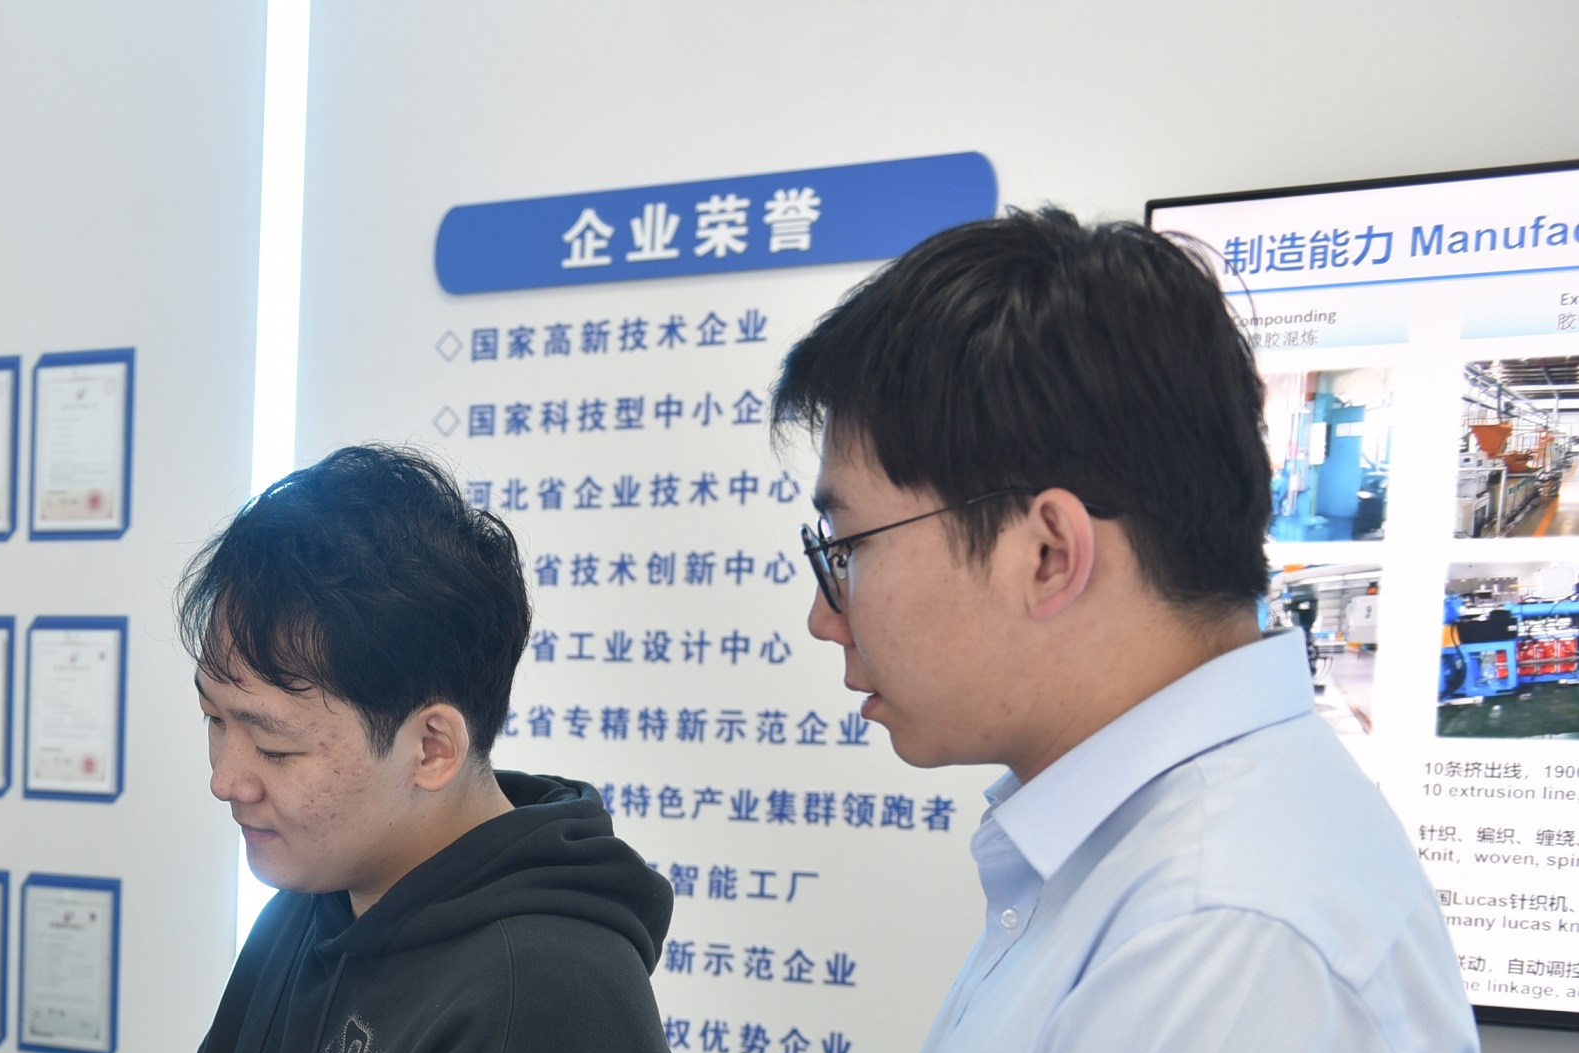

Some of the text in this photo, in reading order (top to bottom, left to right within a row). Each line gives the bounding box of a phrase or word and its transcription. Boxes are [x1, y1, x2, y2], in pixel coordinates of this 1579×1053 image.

[562, 187, 822, 269] 企业荣誉
[1223, 213, 1579, 276] 制造能力 Manufa
[470, 308, 769, 363] 国家高新技术企业
[466, 470, 802, 513] 河北省企业技术中心
[523, 549, 798, 587] 省技术创新中心
[1423, 783, 1443, 797] 10
[1449, 785, 1536, 799] extrusion
[1475, 852, 1539, 868] woven,
[649, 862, 820, 903] 智能工厂
[1503, 915, 1552, 932] lucas
[1488, 979, 1559, 1000] linkage,
